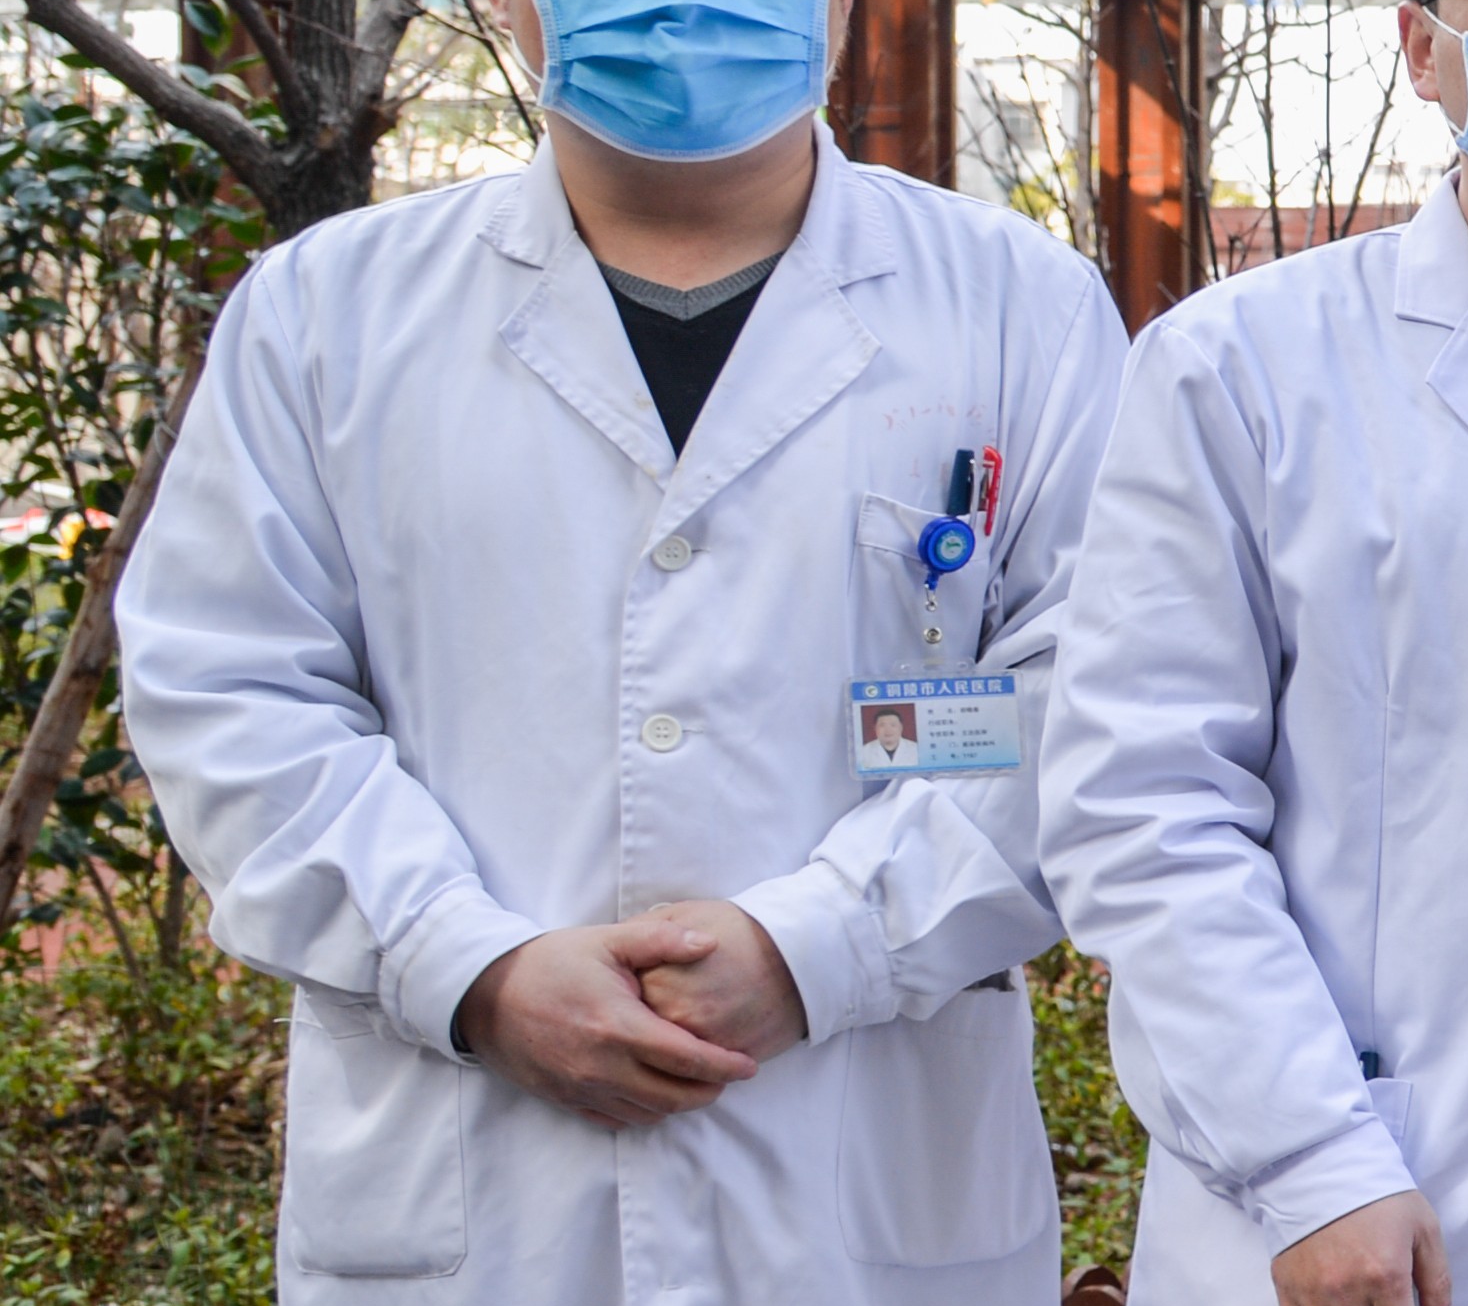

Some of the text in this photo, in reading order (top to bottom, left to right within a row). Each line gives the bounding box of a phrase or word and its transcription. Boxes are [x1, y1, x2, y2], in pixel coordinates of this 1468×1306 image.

[885, 678, 1004, 698] 铜陵市人民医院
